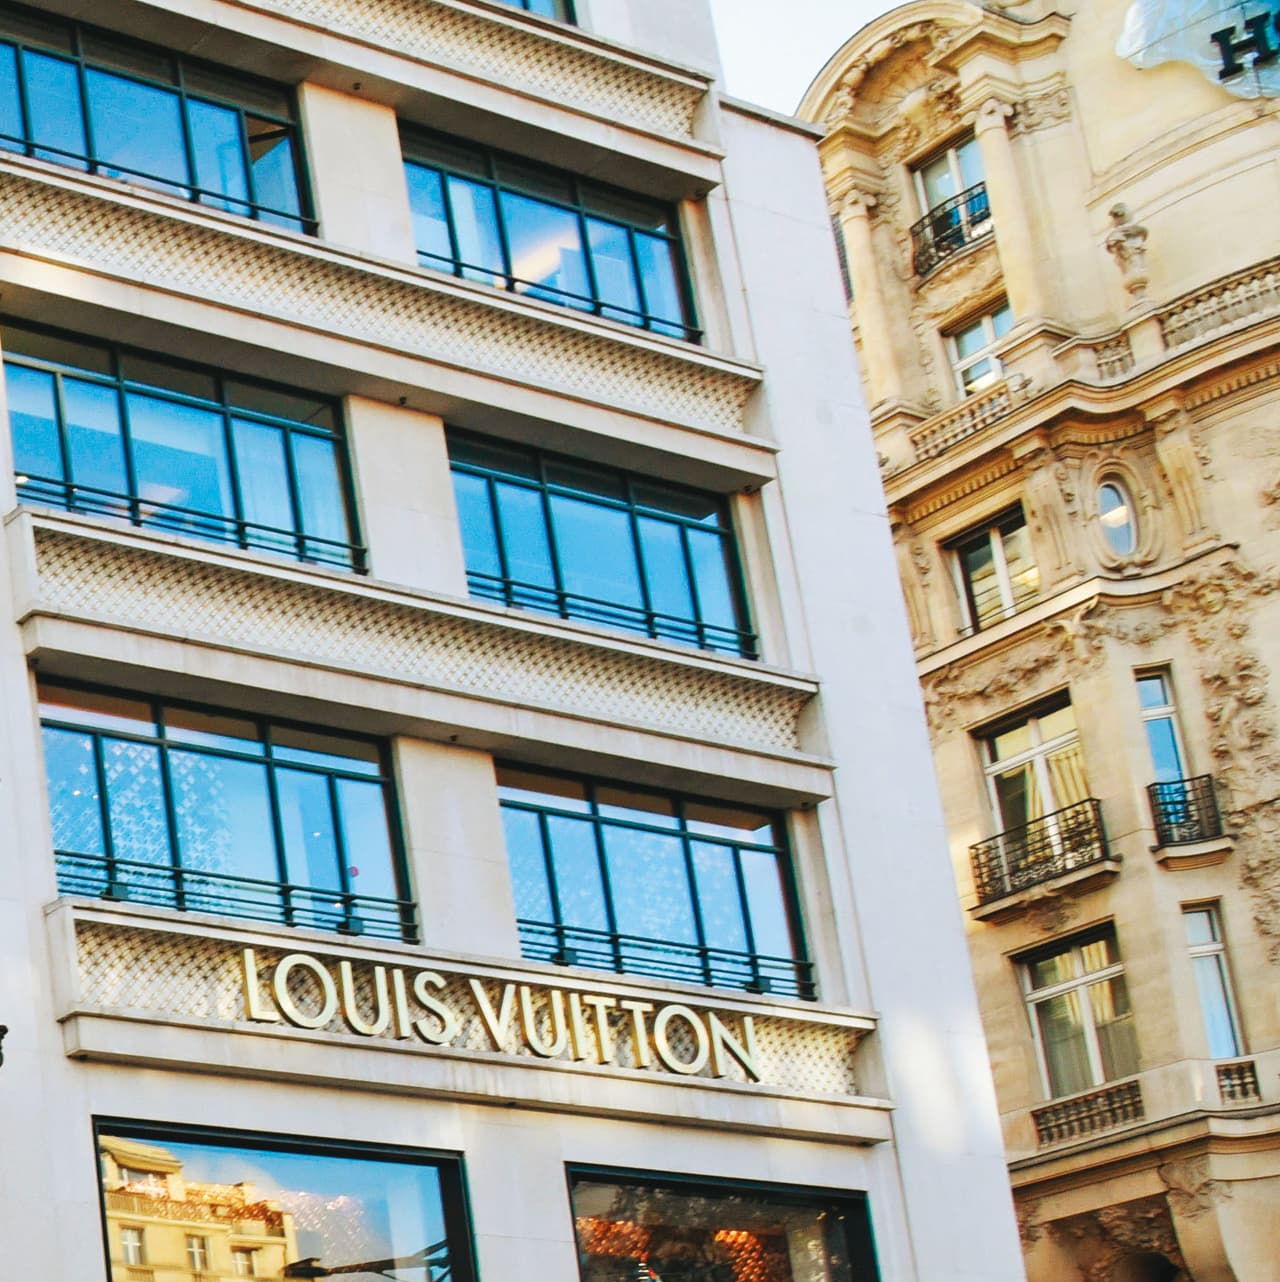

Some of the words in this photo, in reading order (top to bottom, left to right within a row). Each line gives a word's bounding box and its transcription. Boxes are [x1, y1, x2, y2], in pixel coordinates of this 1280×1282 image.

[1209, 11, 1280, 81] H
[242, 947, 458, 1045] LOUIS
[469, 978, 760, 1083] VUITTON
